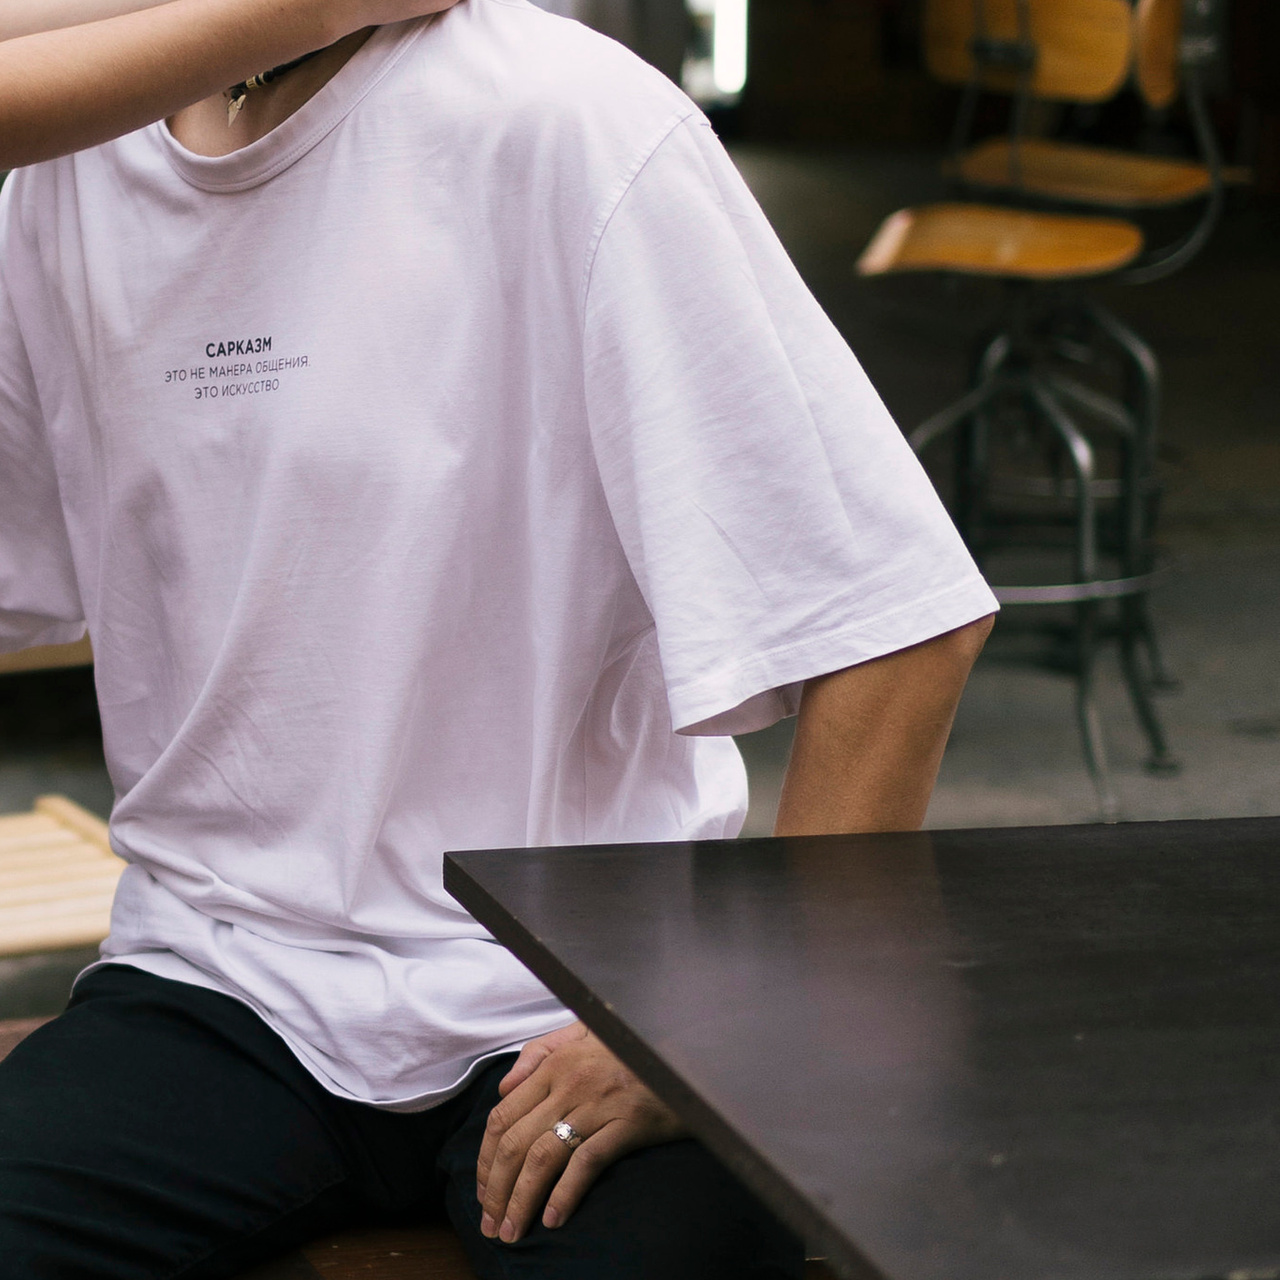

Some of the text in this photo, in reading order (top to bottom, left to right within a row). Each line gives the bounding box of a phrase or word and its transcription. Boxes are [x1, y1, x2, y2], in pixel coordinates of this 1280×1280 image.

[205, 336, 272, 358] САРКАЗМ
[164, 369, 187, 383] ЭТО
[190, 367, 205, 379] НЕ
[209, 363, 253, 378] МАНЕРА
[194, 378, 280, 400] ЭТО ИСКУССТВО
